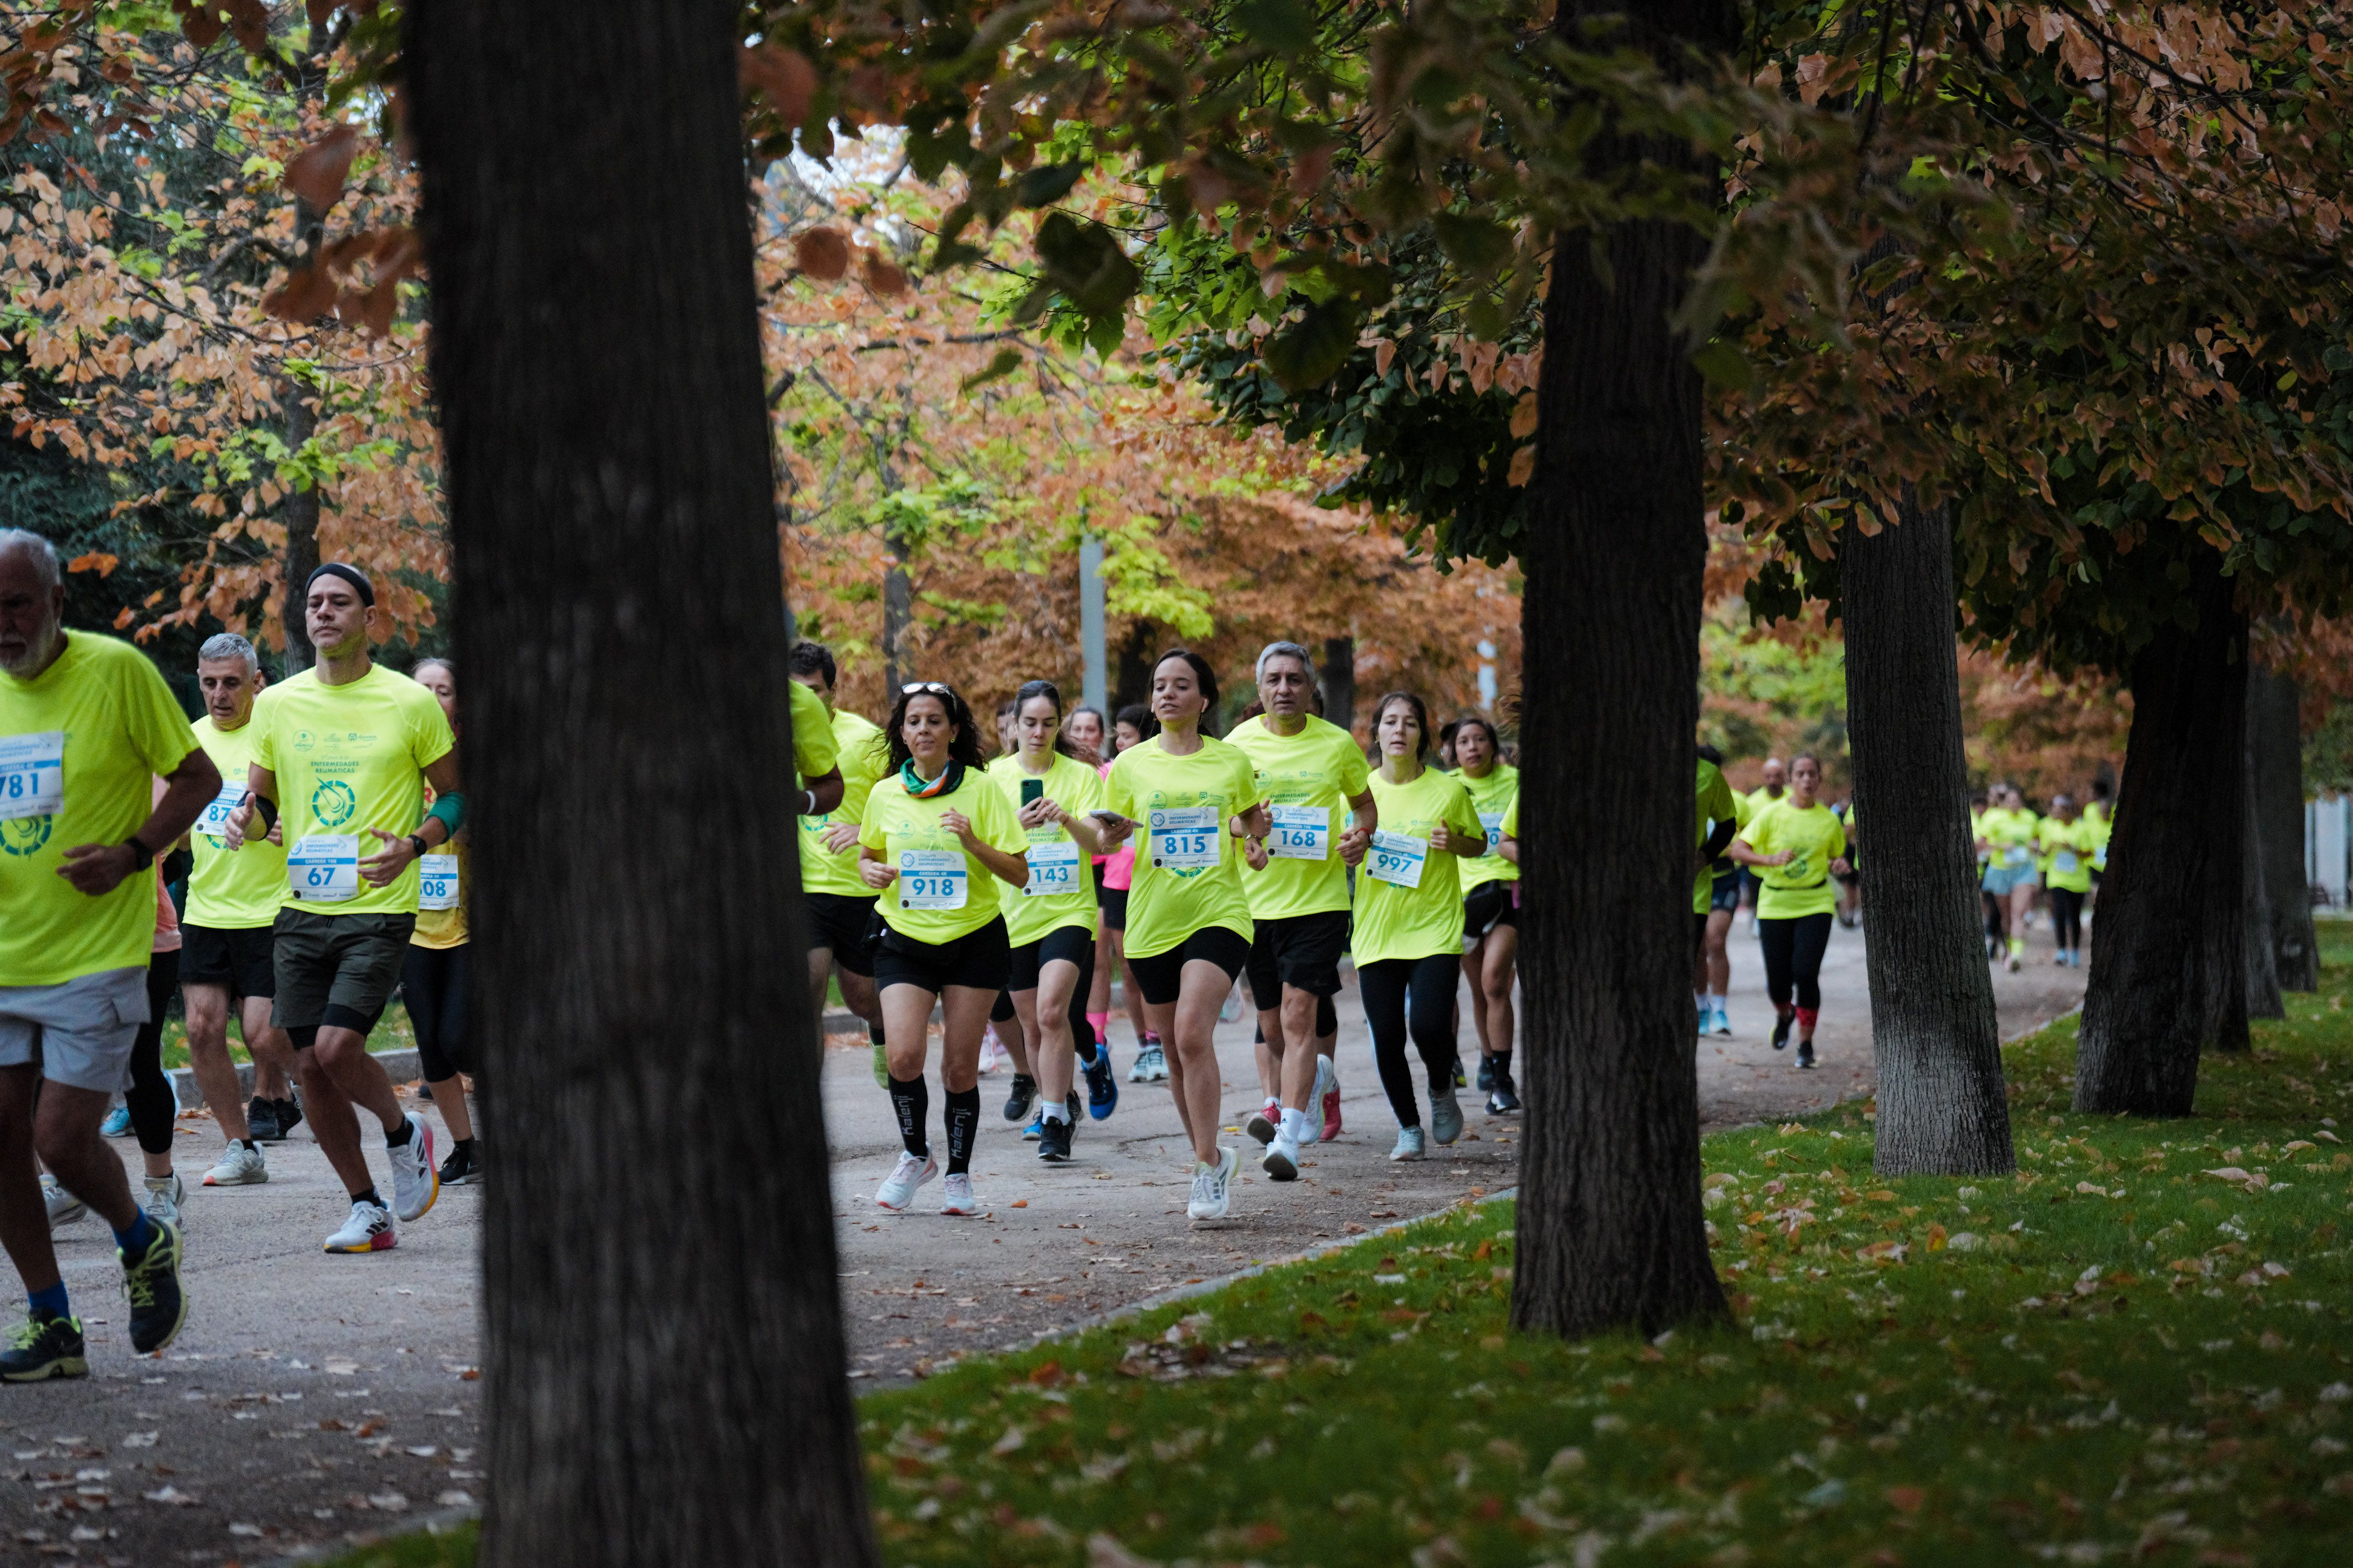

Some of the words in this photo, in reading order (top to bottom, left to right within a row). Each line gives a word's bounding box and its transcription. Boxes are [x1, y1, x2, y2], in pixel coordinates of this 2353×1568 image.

[1165, 836, 1206, 854] 815
[1281, 830, 1316, 847] 168
[1377, 854, 1413, 873] 997
[308, 867, 336, 886] 67
[1034, 867, 1069, 883] 143
[420, 881, 446, 897] 08
[912, 878, 954, 896] 918
[950, 1108, 972, 1159] Kalenji
